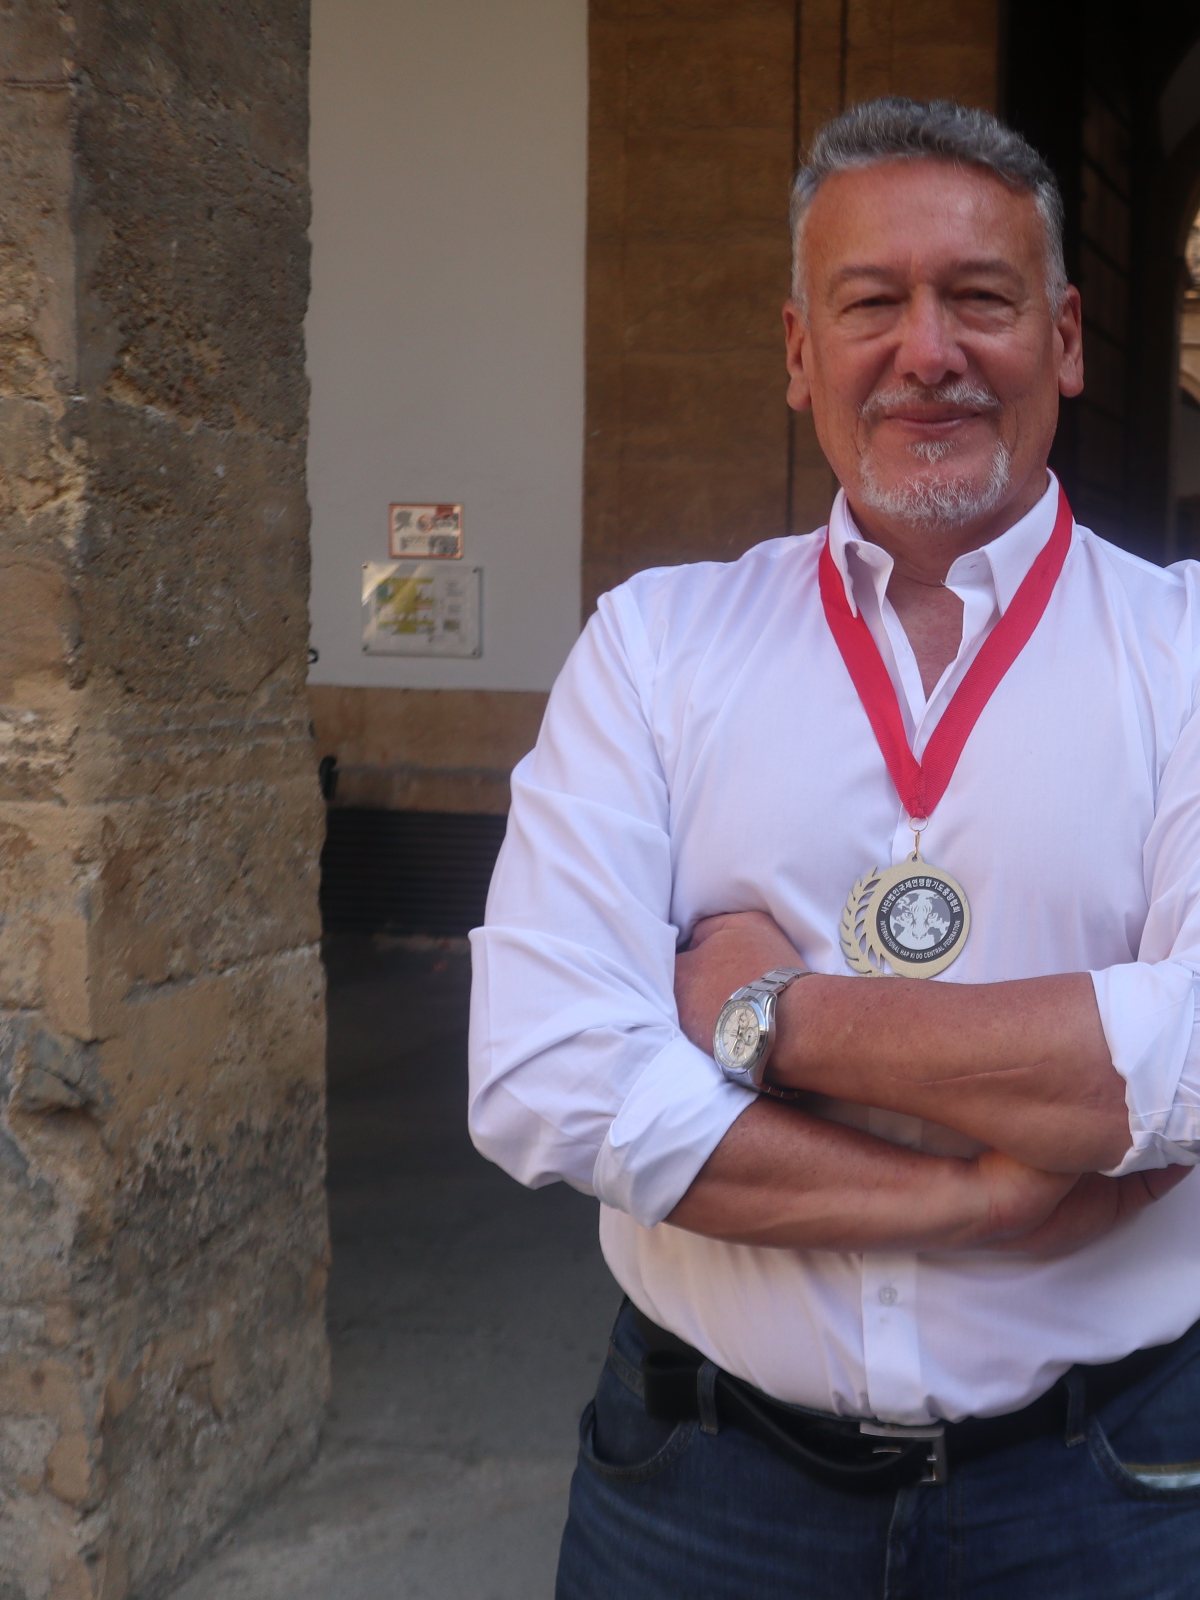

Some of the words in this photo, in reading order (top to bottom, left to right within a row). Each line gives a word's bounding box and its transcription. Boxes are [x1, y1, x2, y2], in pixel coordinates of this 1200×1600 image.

[880, 920, 900, 954] INTERNATIONAL
[900, 949, 910, 958] HAP
[924, 946, 945, 959] CENTRAL
[943, 920, 961, 948] FEDERATION
